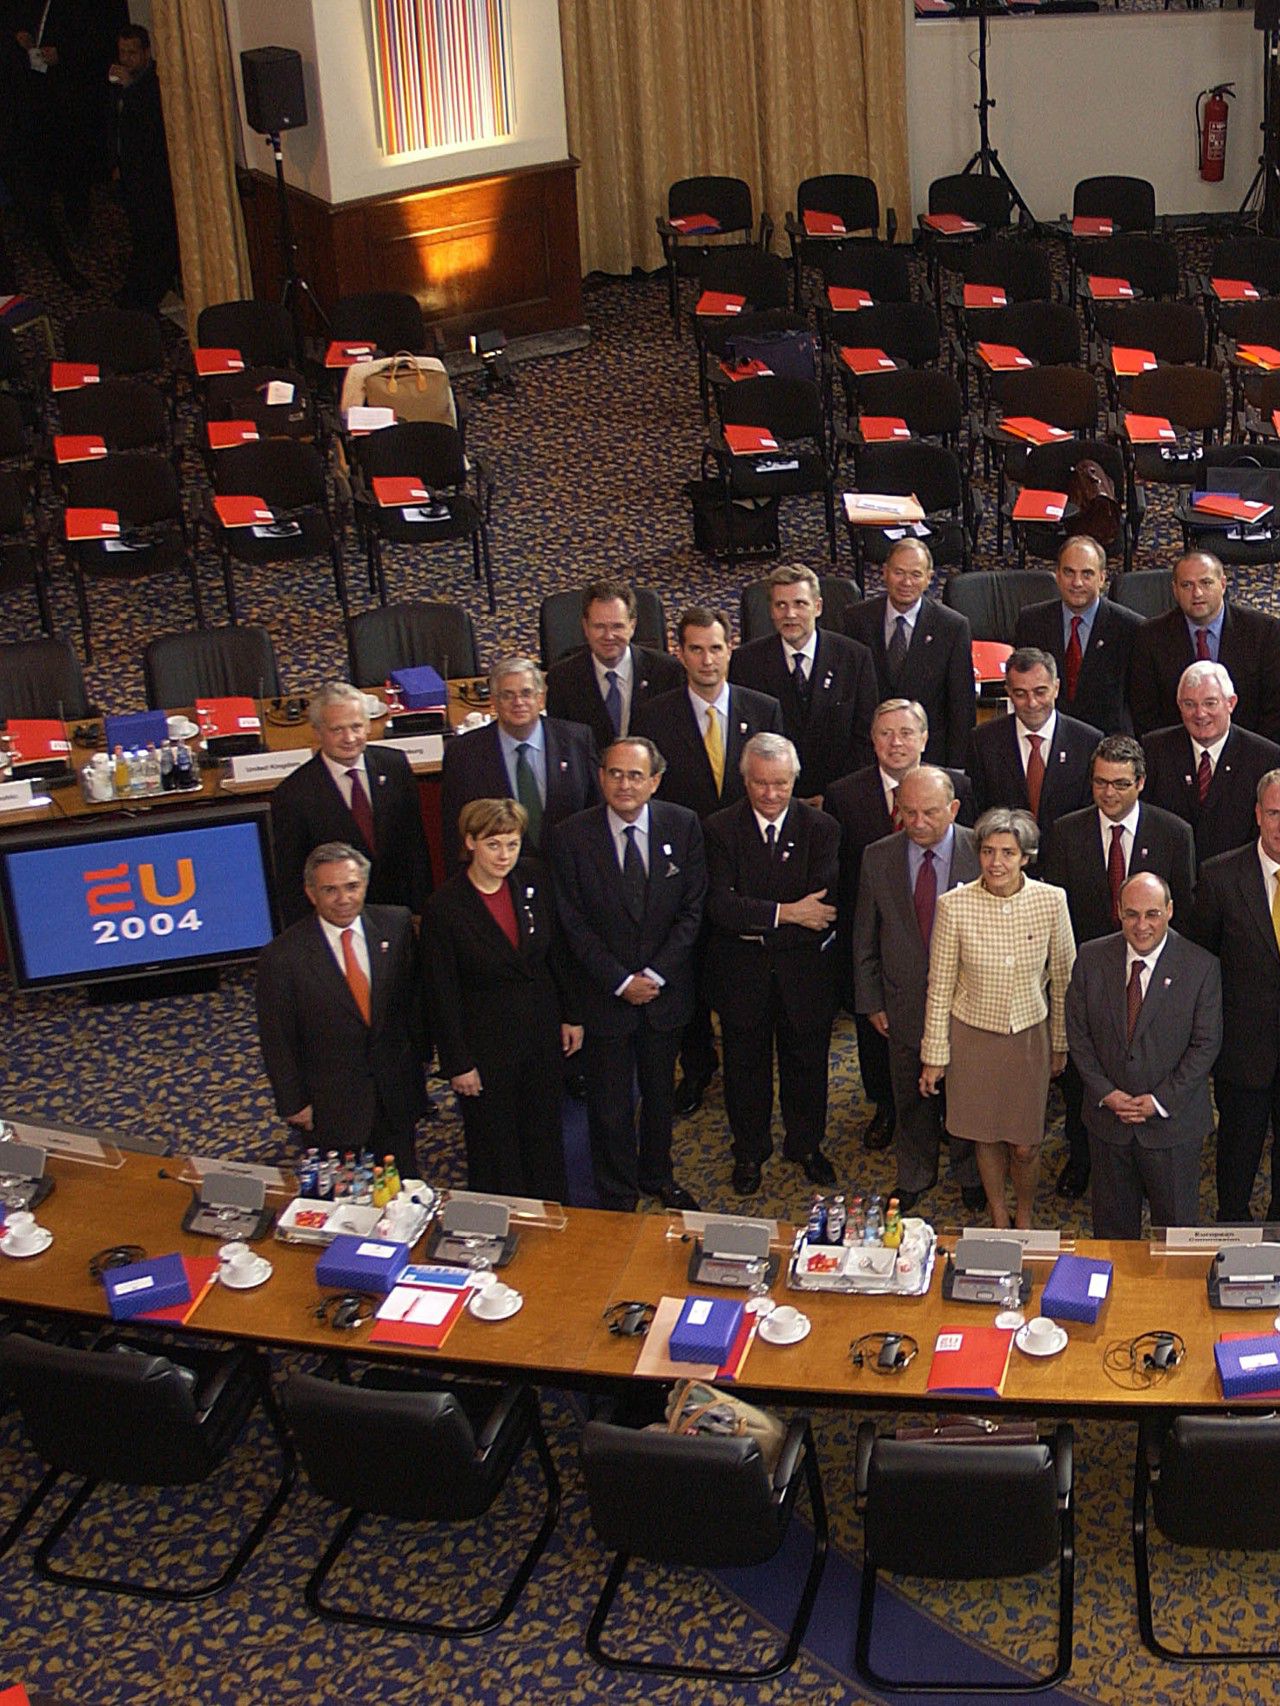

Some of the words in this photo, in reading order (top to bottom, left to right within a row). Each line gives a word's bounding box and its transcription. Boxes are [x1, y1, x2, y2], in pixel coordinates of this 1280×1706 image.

[246, 765, 268, 773] United
[84, 858, 196, 916] EU
[93, 909, 203, 944] 2004
